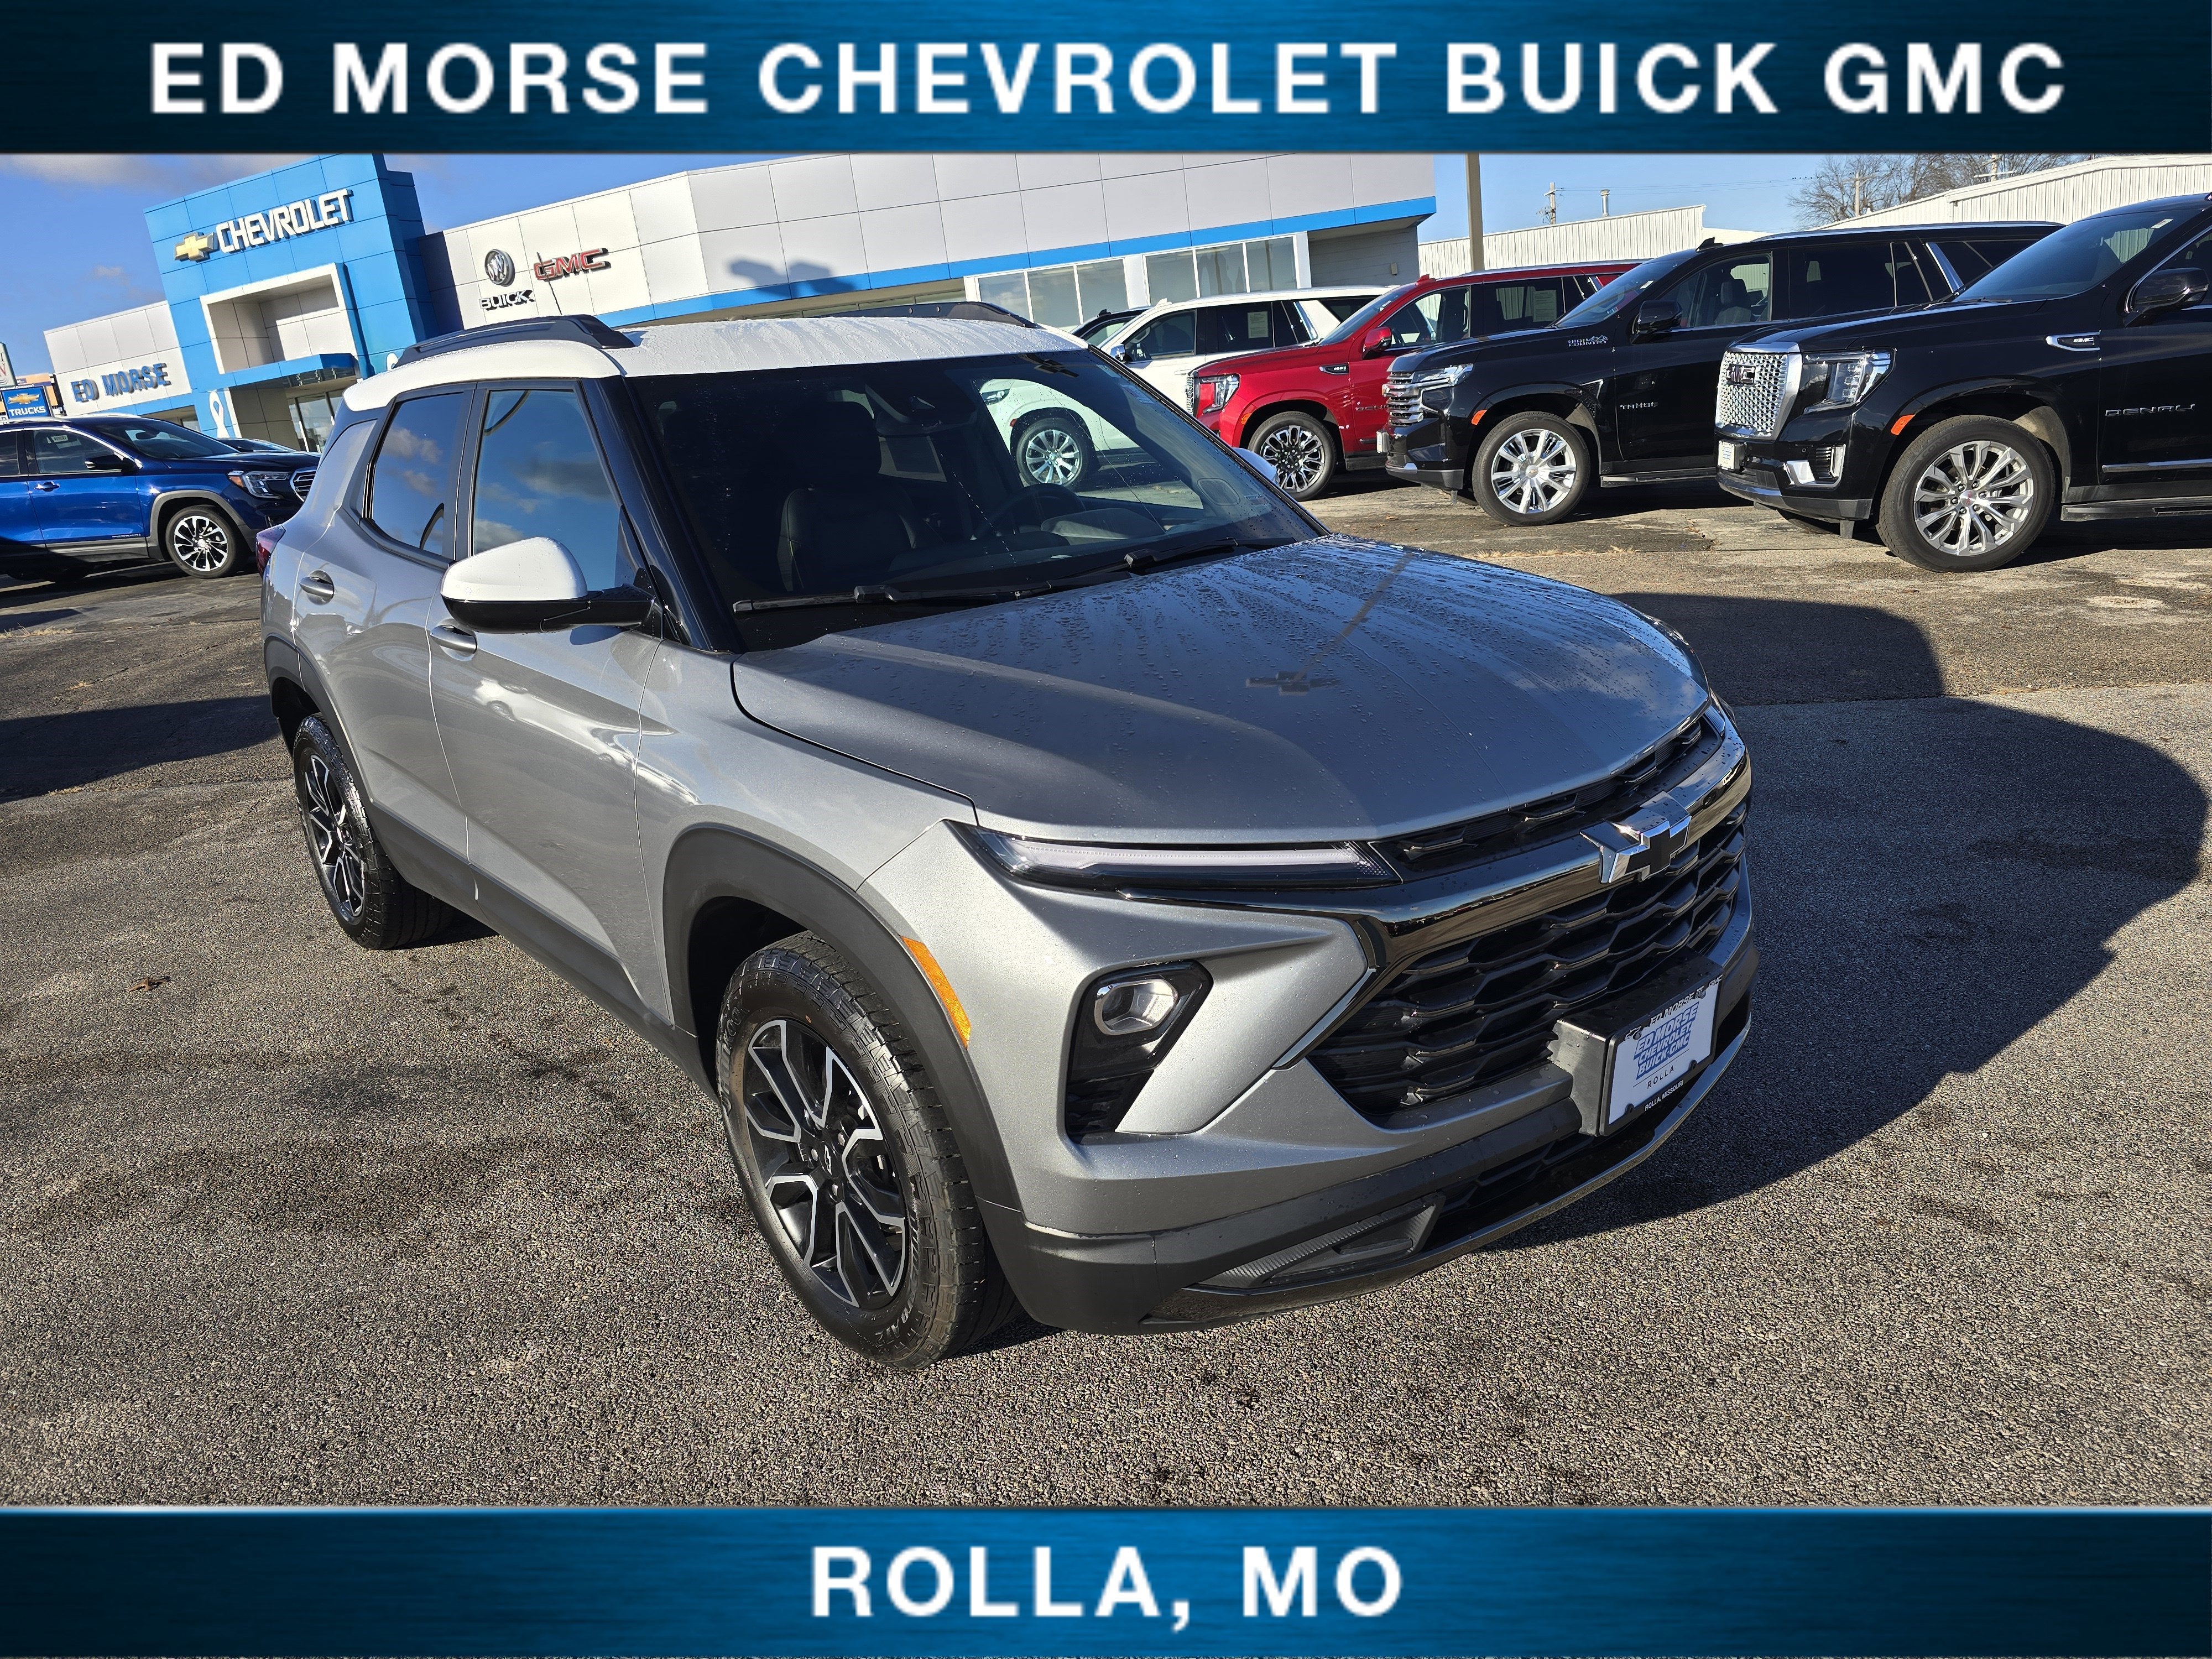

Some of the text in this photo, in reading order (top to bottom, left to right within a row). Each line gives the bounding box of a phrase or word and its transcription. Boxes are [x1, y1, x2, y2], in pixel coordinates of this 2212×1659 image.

[216, 189, 351, 253] CHEVROLET
[533, 248, 606, 281] GMC
[479, 290, 532, 310] BUICK
[71, 363, 169, 402] ED MORSE
[8, 405, 46, 416] TRUCKS
[2105, 404, 2195, 416] DENALI
[1651, 992, 1695, 1024] ED MORSE
[1635, 1003, 1699, 1056] ED MORSE
[1639, 1021, 1693, 1064] CHEVROLET
[1647, 1065, 1674, 1089] ROLLA
[1645, 1079, 1684, 1112] ROLLA, MISSOURI
